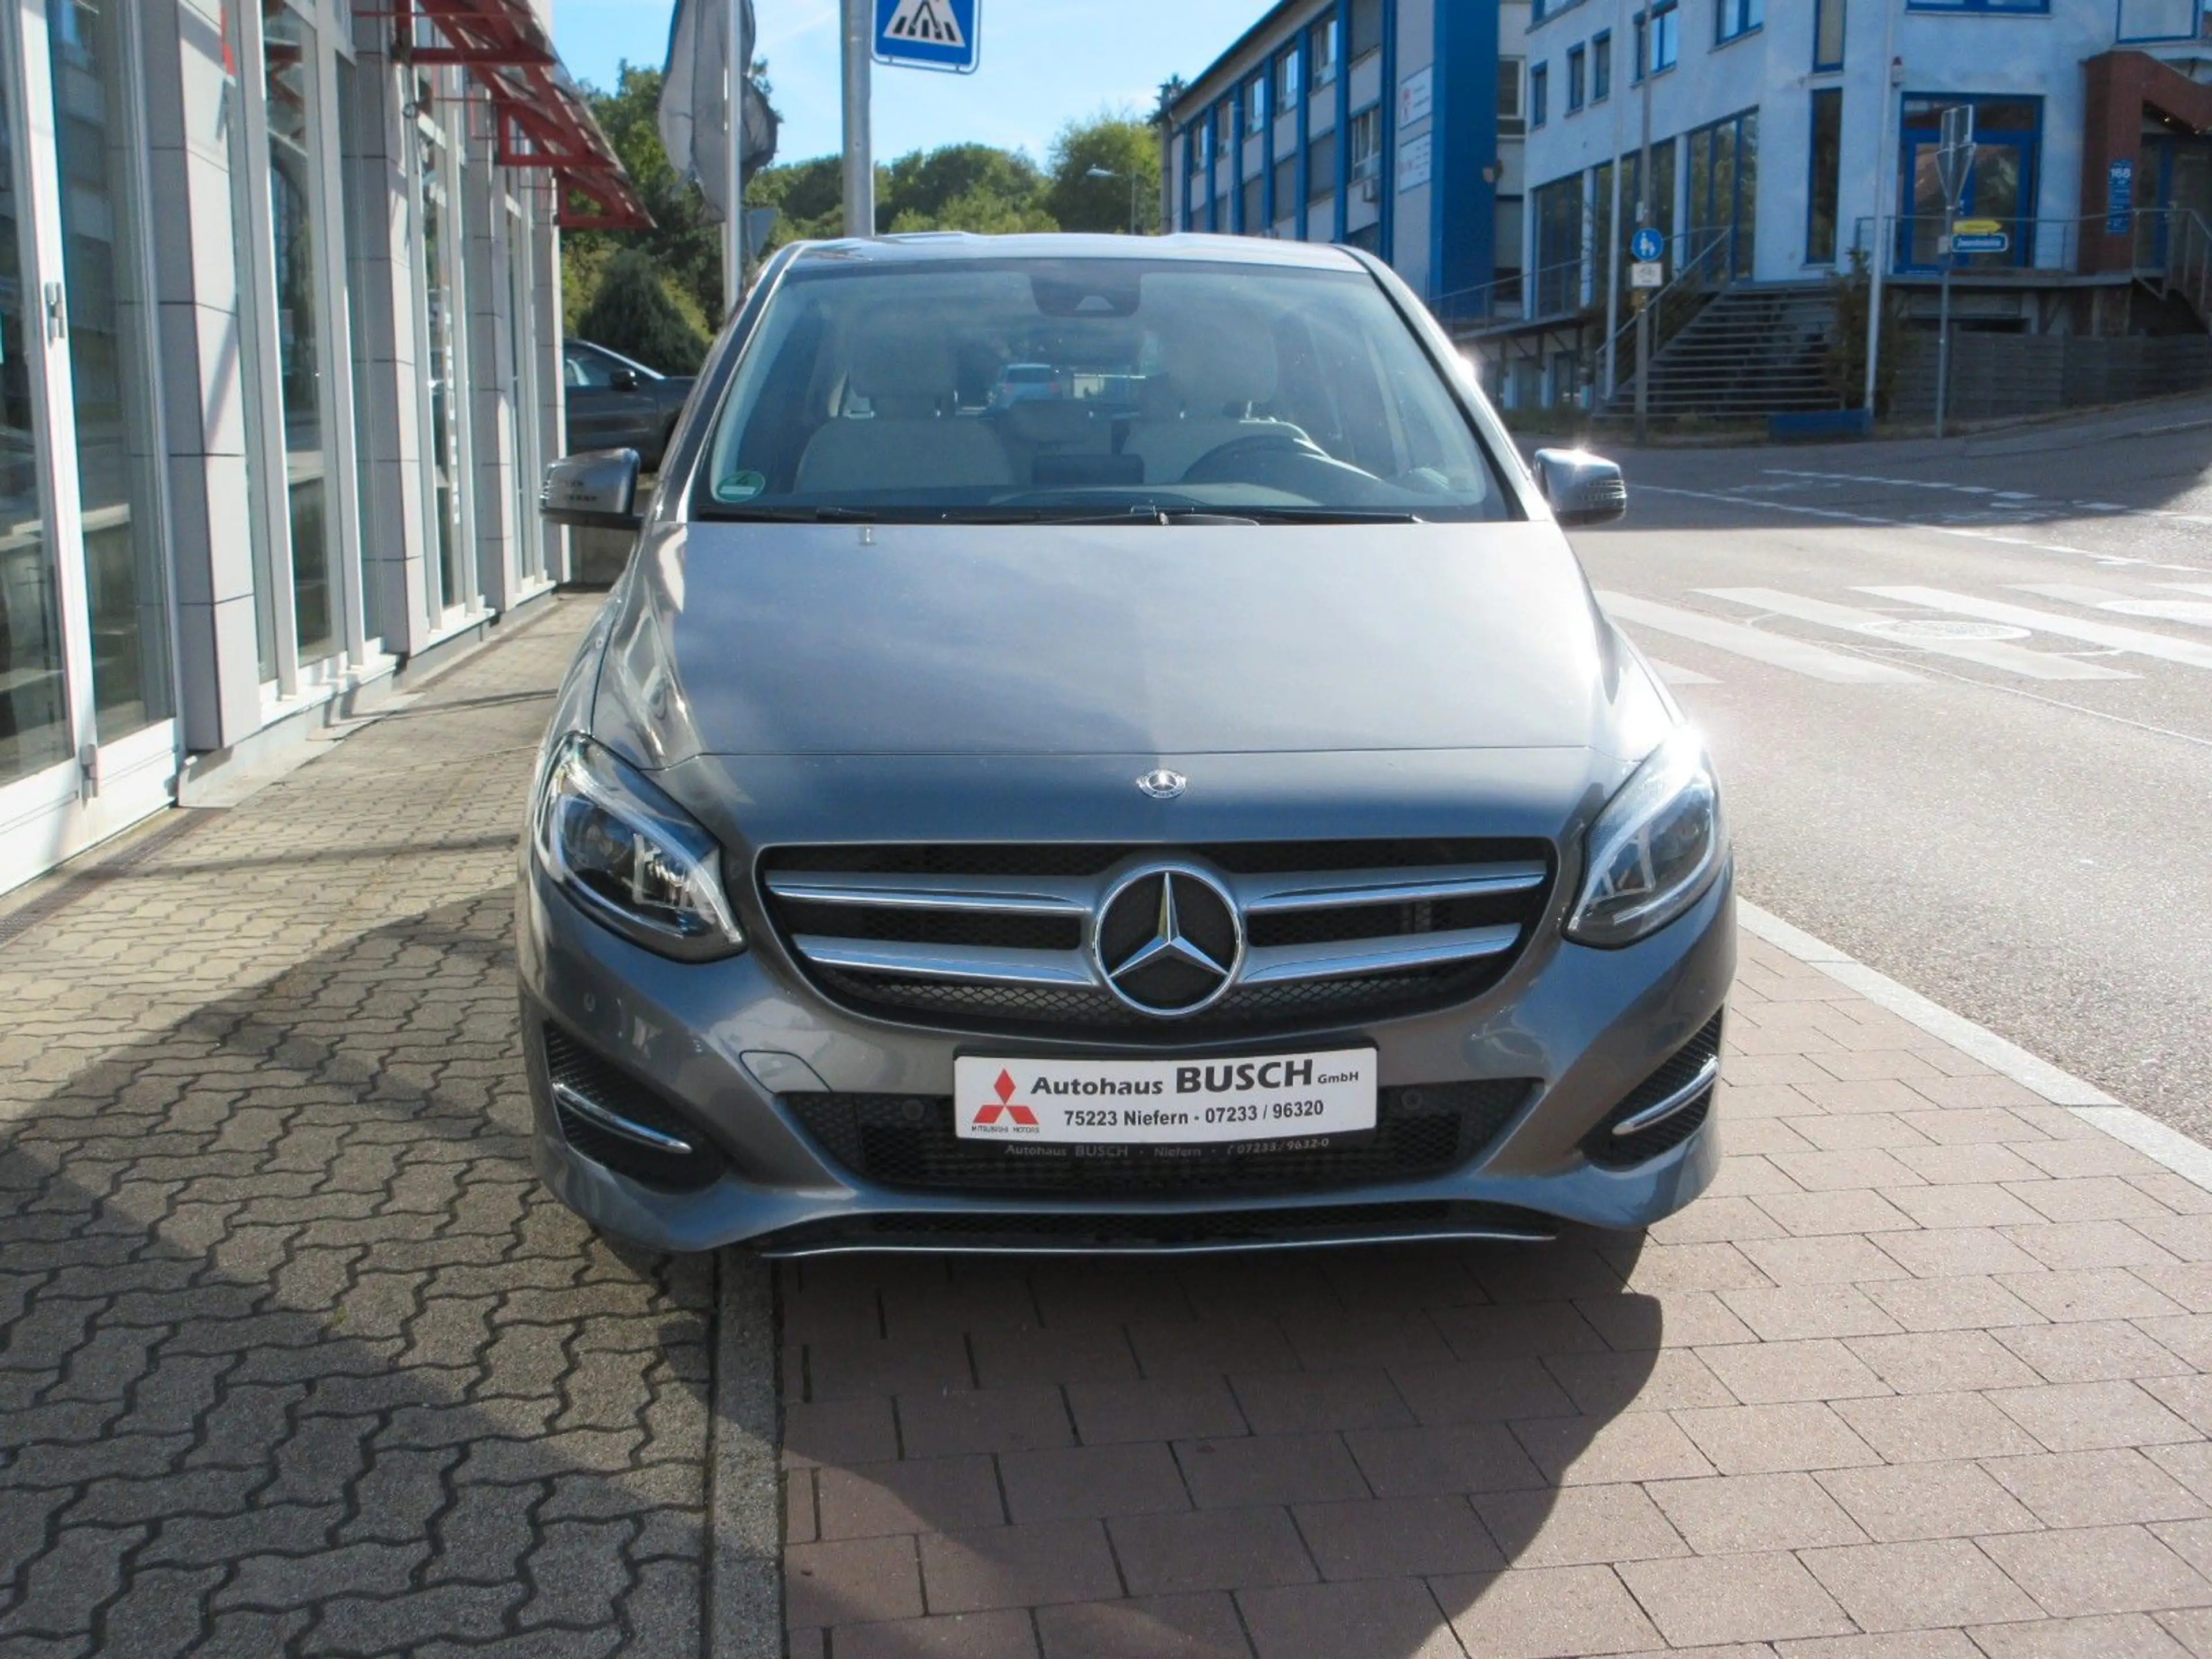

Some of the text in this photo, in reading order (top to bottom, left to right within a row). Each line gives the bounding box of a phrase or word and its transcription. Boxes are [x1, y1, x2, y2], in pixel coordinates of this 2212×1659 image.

[1031, 1059, 1359, 1095] Autohaus BUSCH GmbH
[1065, 1111, 1118, 1126] 75223
[1124, 1109, 1188, 1125] Niefern
[1205, 1105, 1257, 1123] 07233
[1263, 1105, 1267, 1119] /
[1272, 1100, 1323, 1119] 96320
[1006, 1144, 1067, 1156] Autohaus
[1075, 1145, 1128, 1157] BUSCH
[1154, 1146, 1201, 1157] Niefern
